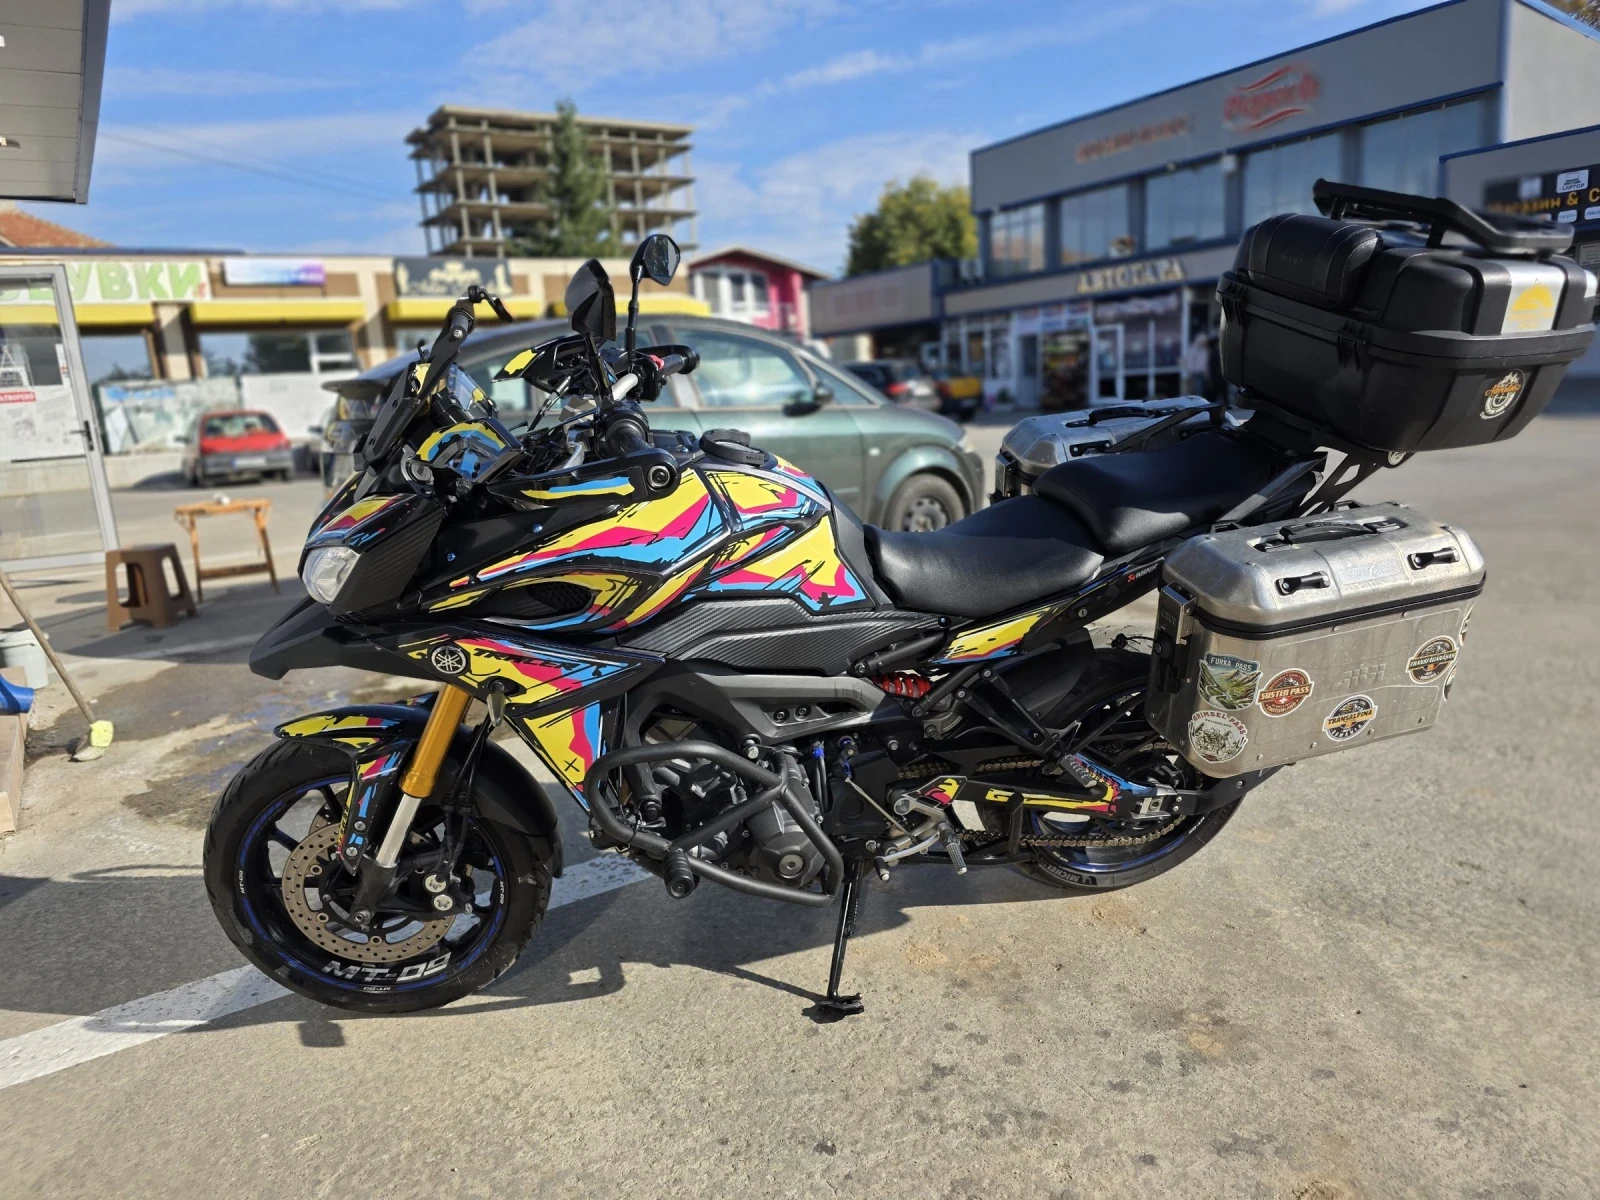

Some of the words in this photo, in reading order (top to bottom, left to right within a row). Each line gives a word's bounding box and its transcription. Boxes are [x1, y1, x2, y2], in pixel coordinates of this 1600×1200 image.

[473, 648, 580, 670] TRACER
[1210, 656, 1232, 667] FURKA
[1235, 662, 1253, 672] PASS
[1260, 689, 1290, 700] SUSTEN
[1290, 686, 1310, 695] PASS
[1193, 711, 1227, 721] GRIMSEL
[1229, 717, 1246, 735] PASS
[1328, 709, 1373, 725] TRANSALPINA
[321, 952, 452, 982] MT-09
